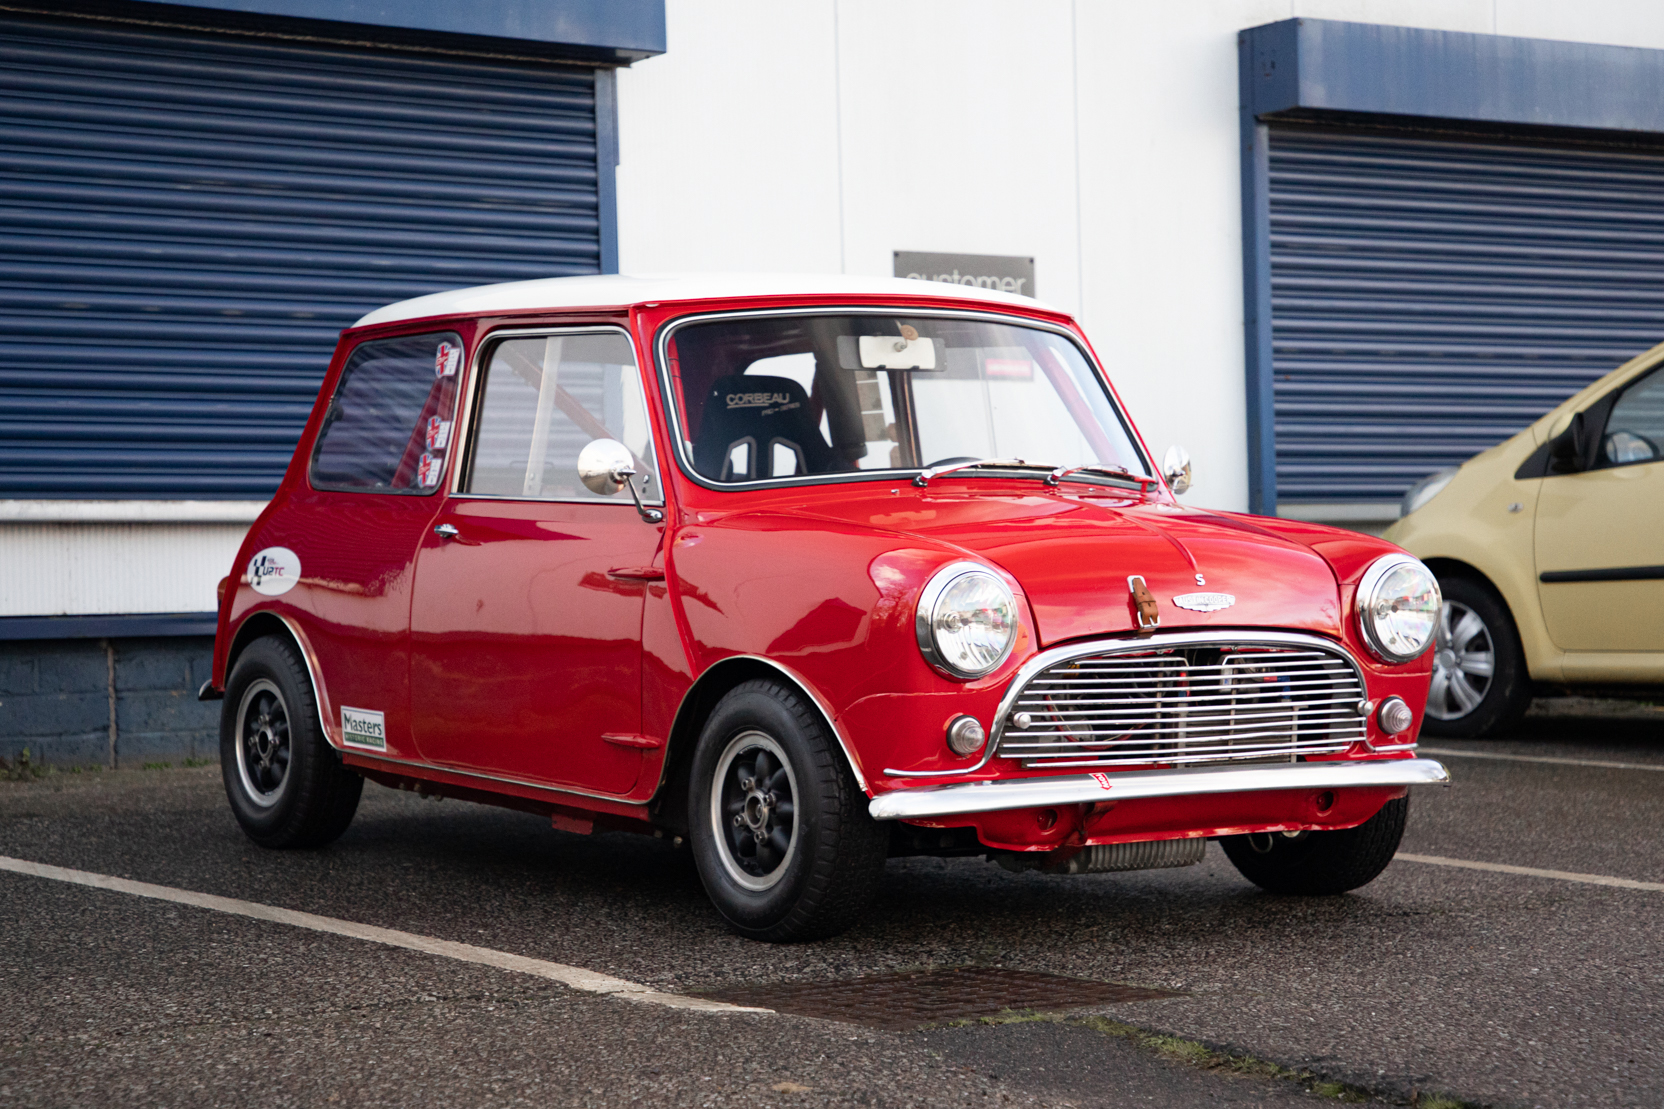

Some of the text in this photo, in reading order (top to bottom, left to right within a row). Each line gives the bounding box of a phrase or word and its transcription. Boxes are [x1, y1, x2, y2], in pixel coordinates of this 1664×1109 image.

[726, 393, 790, 405] CORBEAU
[263, 567, 284, 576] U2TC
[1195, 574, 1206, 585] S
[1205, 595, 1231, 604] COOPER
[344, 713, 382, 735] Masters
